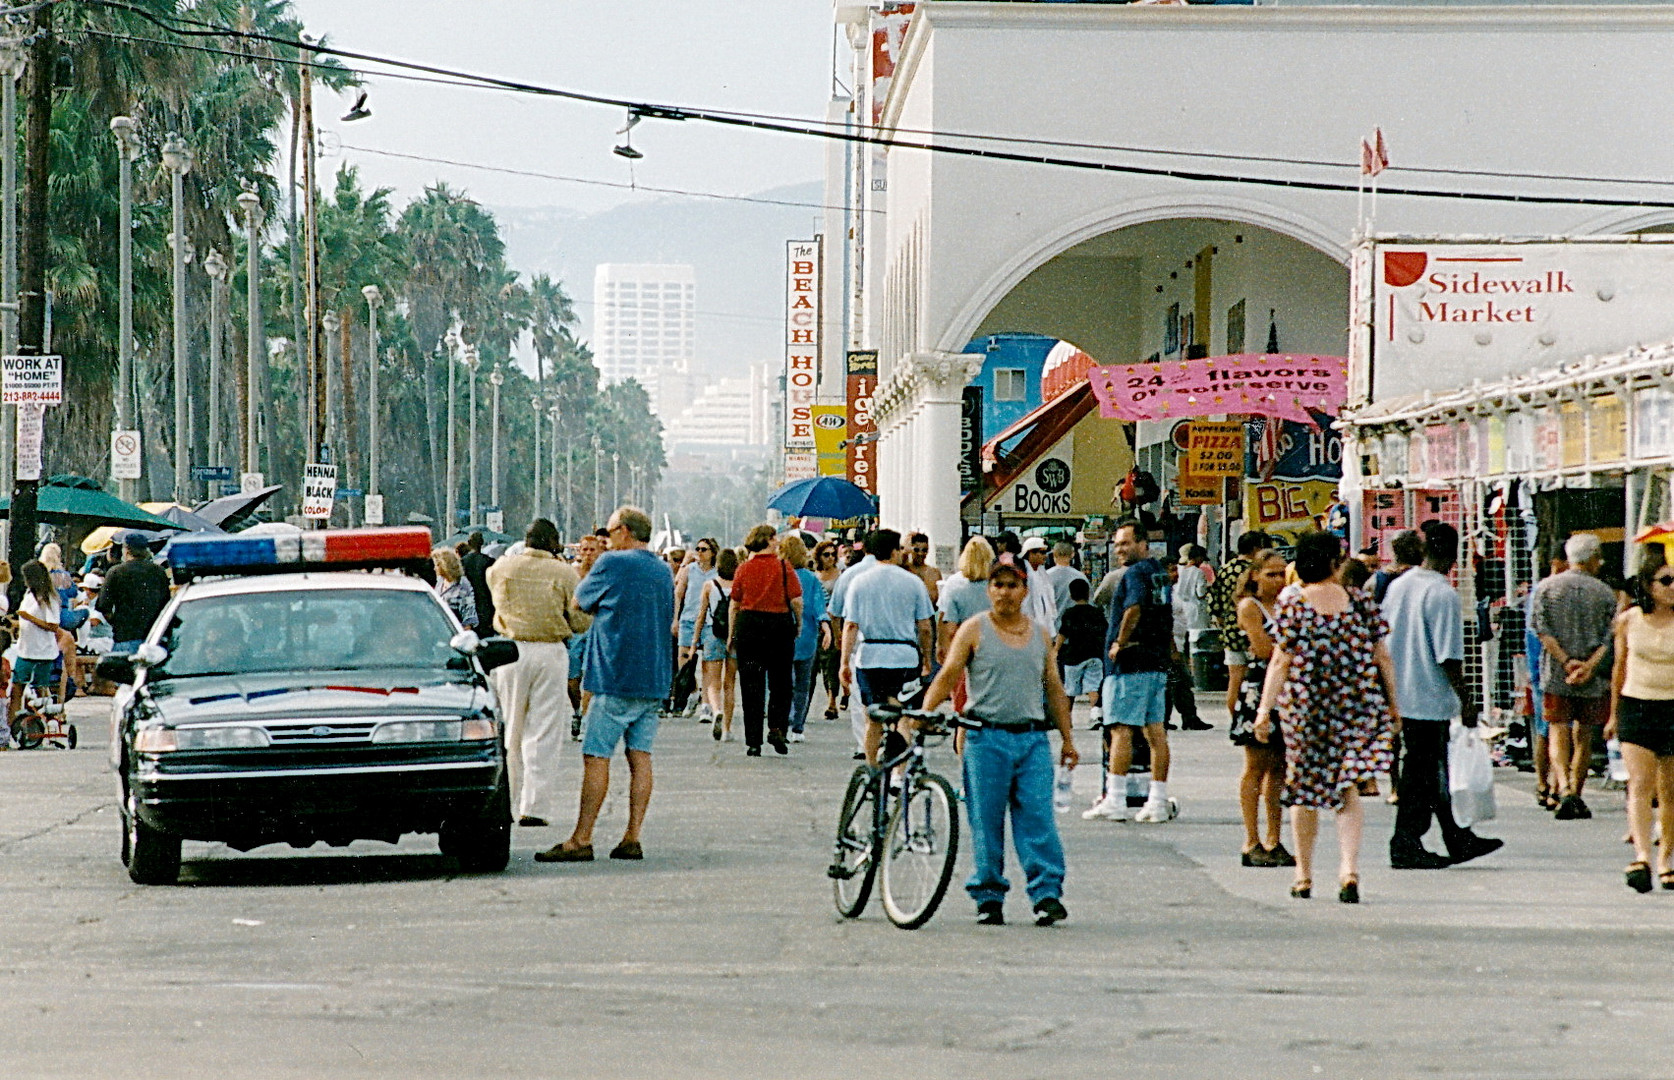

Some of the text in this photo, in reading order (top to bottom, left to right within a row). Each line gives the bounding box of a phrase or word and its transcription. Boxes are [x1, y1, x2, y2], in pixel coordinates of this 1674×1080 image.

[794, 245, 812, 257] The
[1429, 271, 1574, 294] Sidewalk
[791, 260, 814, 343] BEACH
[1418, 301, 1535, 322] Market
[3, 359, 60, 370] WORK AT
[1127, 375, 1166, 389] 24
[1206, 368, 1331, 381] flavors
[1249, 380, 1329, 391] serve
[790, 355, 814, 438] HOUSE
[1192, 435, 1241, 449] PIZZA
[1200, 451, 1233, 460] $2.00
[306, 466, 336, 479] HENNA
[305, 485, 333, 499] BLACK
[1185, 488, 1216, 498] Kodak
